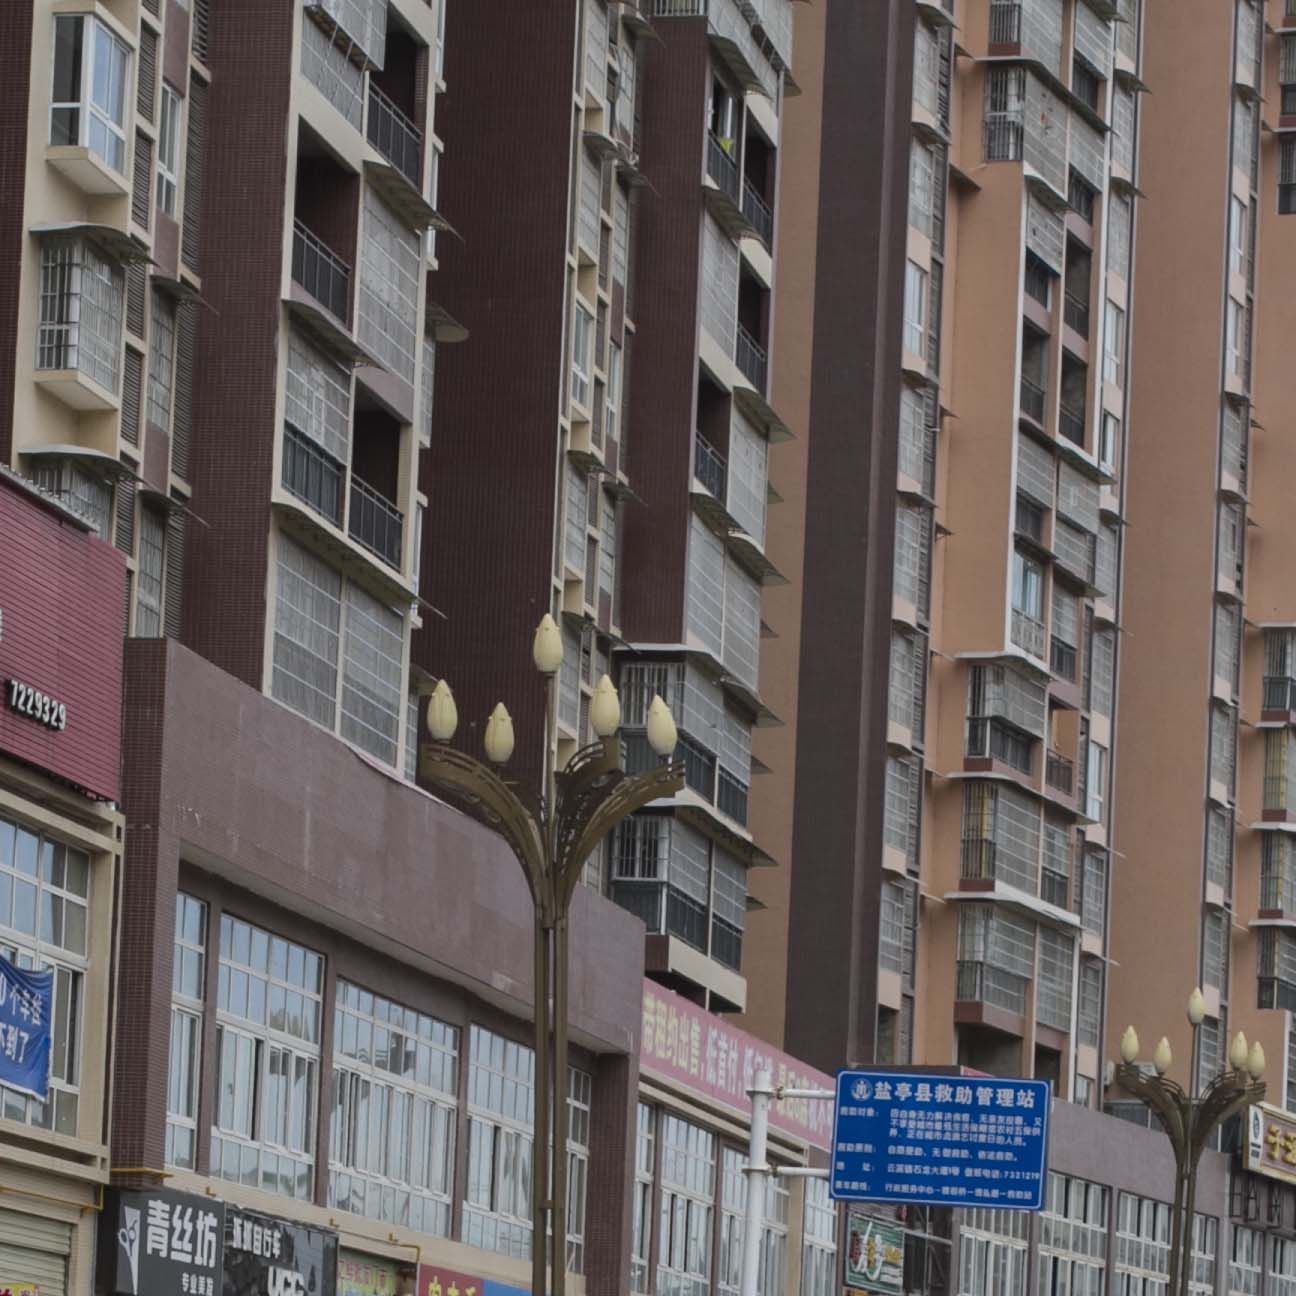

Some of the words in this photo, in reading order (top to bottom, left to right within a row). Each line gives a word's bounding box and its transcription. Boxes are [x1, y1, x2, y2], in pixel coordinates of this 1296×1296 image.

[10, 679, 67, 731] 7229329
[874, 1081, 1036, 1109] 盐亭县救助管理站
[146, 1199, 218, 1268] 青丝坊
